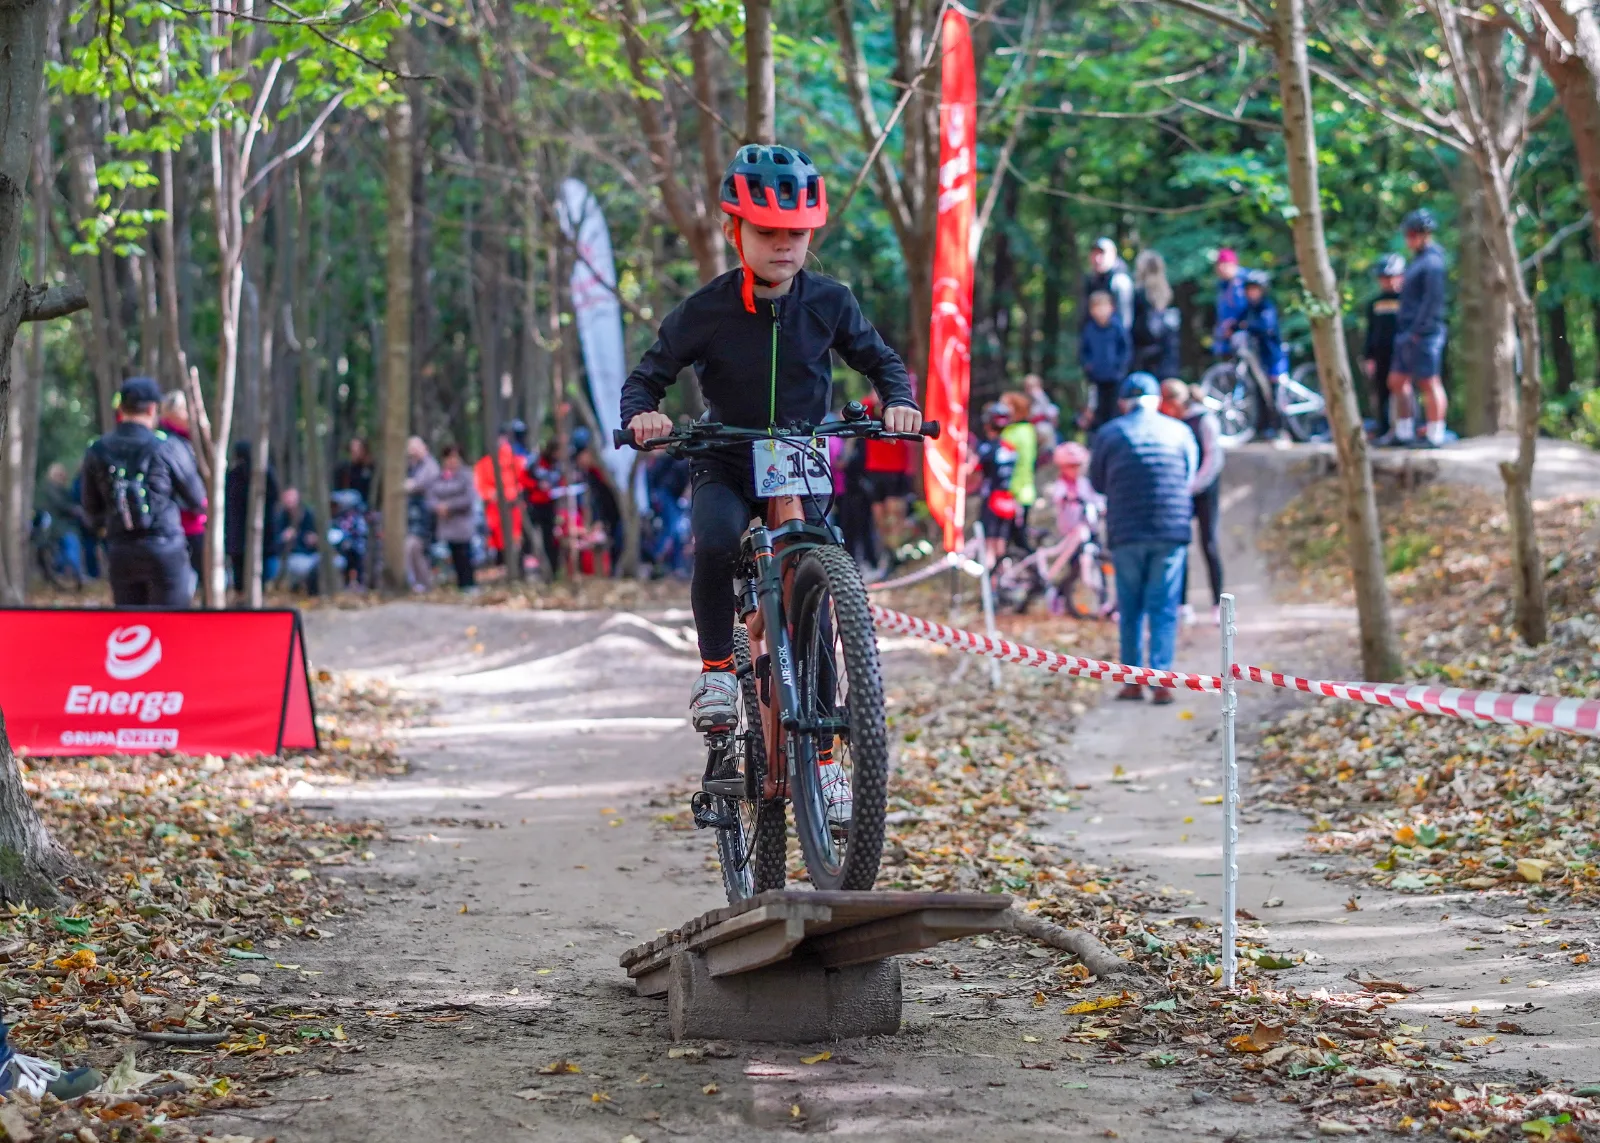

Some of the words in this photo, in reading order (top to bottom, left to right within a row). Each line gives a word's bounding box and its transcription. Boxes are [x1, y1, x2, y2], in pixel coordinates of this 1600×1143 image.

[787, 451, 827, 478] 13
[777, 645, 793, 687] AIRFORK
[65, 685, 184, 723] Energa
[60, 730, 116, 747] GRUPA
